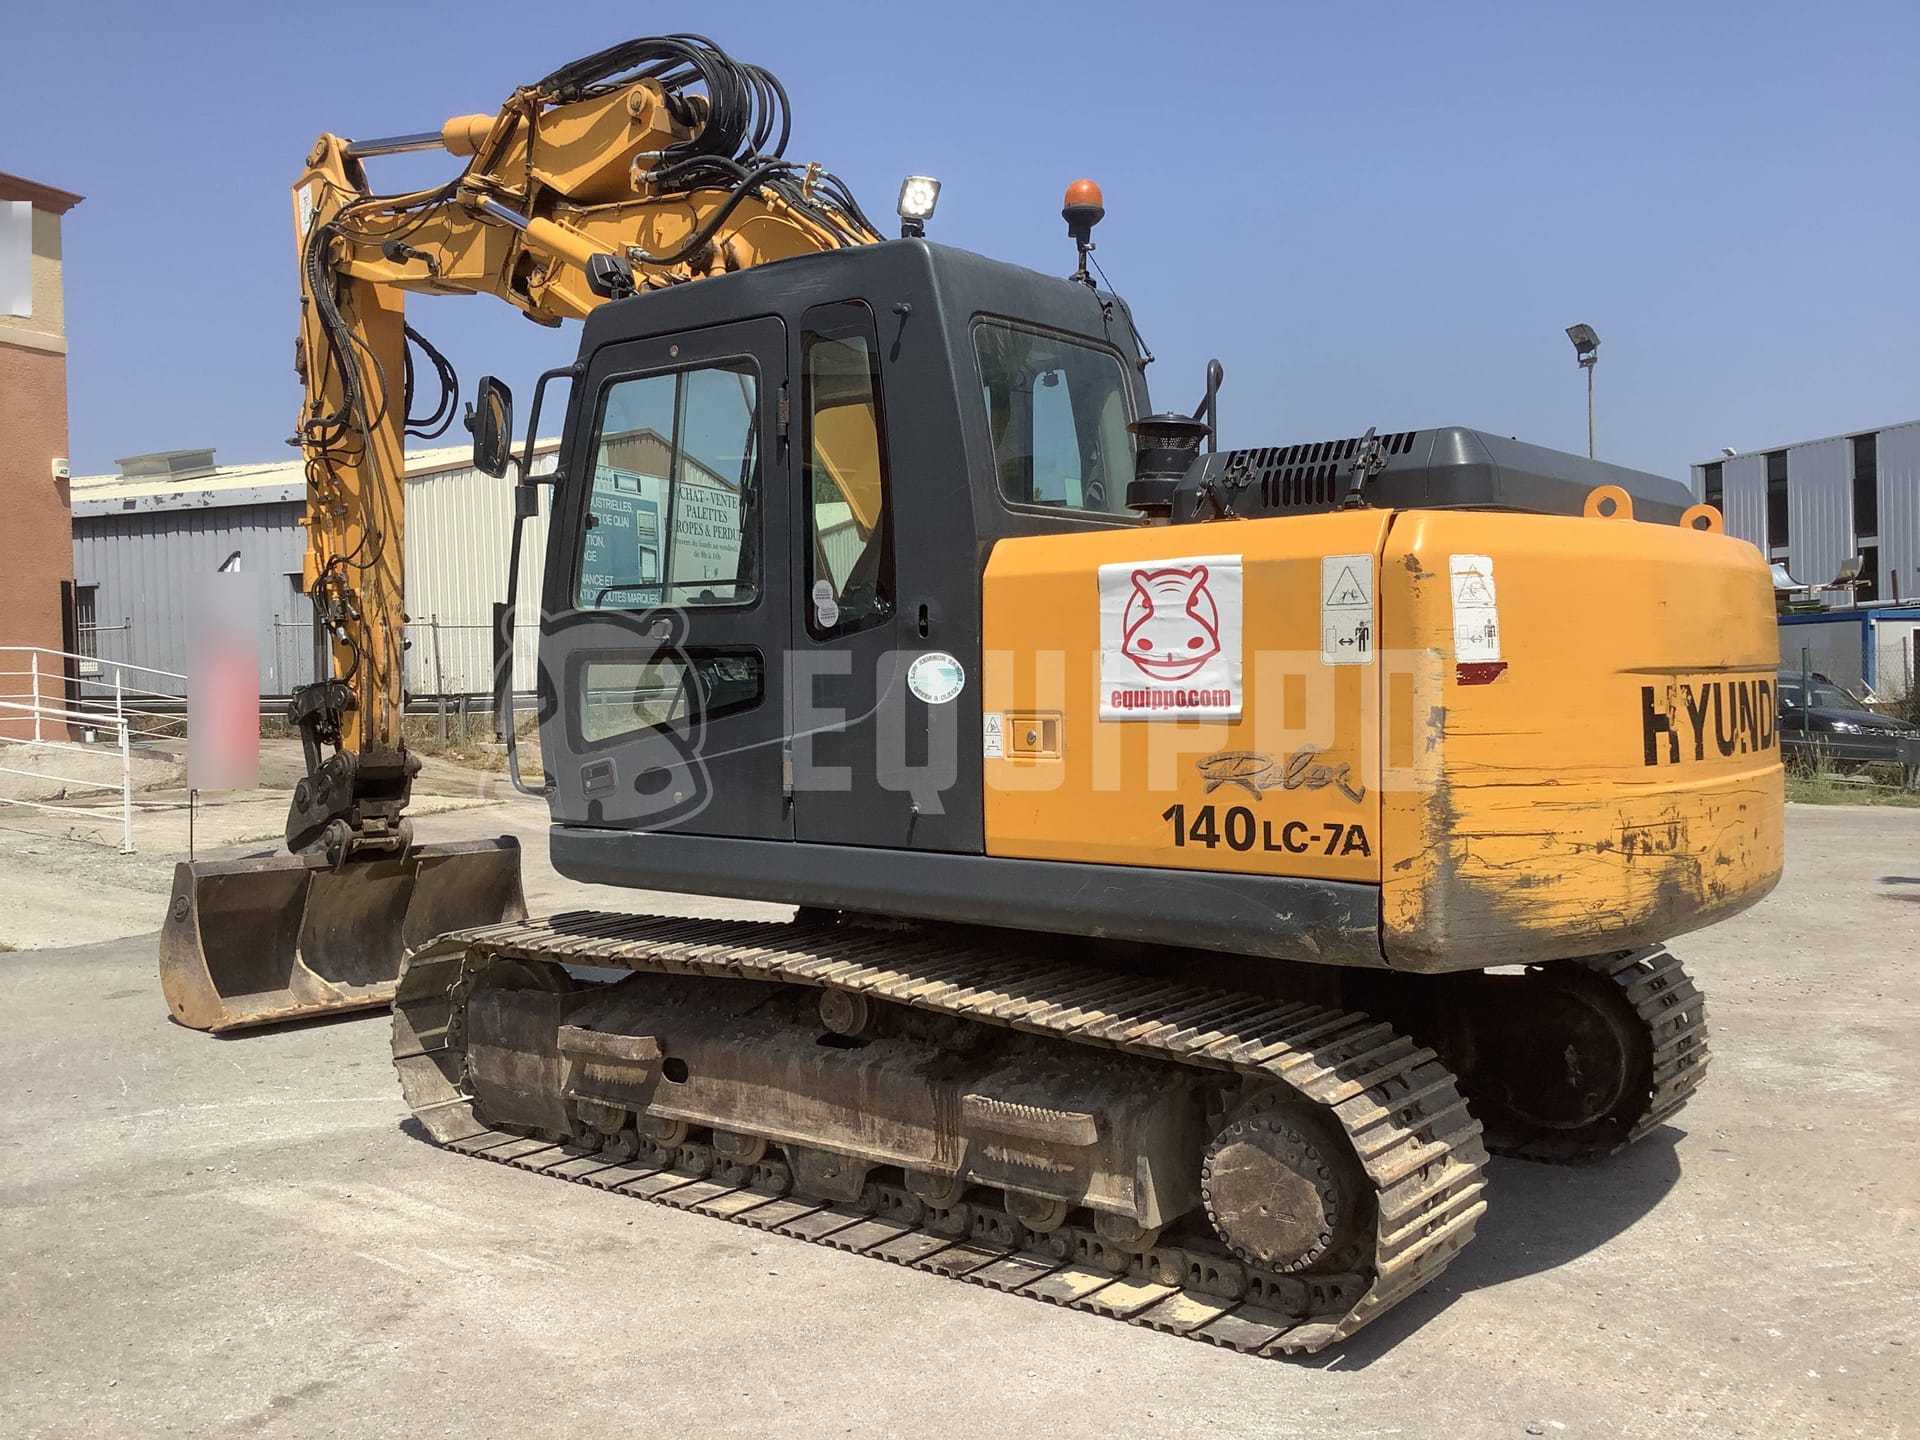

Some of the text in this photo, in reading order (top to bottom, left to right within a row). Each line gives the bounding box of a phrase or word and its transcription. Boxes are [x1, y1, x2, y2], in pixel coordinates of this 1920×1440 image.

[591, 496, 634, 514] USTRIELLES,
[679, 486, 704, 503] CHAT
[710, 492, 738, 509] VENTE
[686, 504, 728, 523] PALETTES
[586, 534, 605, 548] TION,
[705, 524, 712, 538] &
[713, 525, 741, 541] PERDU
[1111, 687, 1231, 710] equippo.com
[1641, 679, 1778, 766] HYUND
